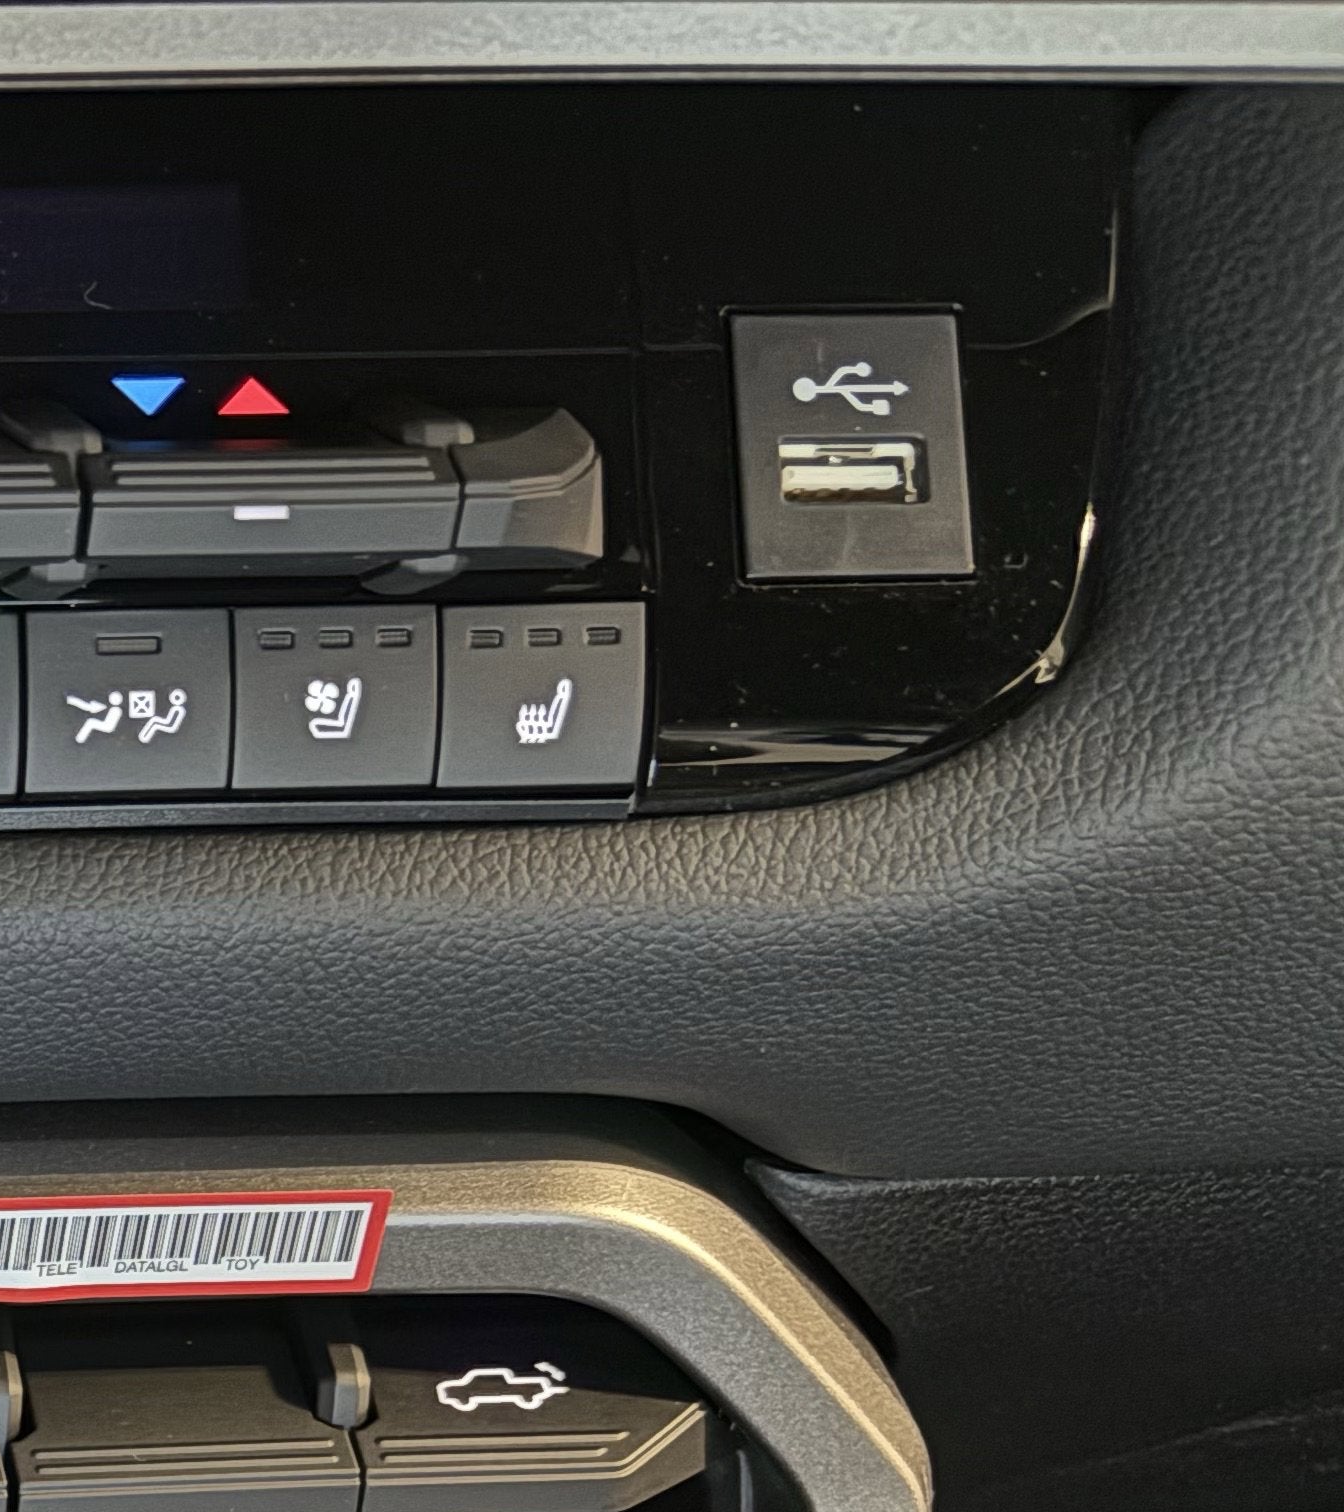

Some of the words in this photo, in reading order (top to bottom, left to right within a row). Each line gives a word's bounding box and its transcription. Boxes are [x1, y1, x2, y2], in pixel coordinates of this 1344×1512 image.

[36, 1262, 78, 1277] TELE
[114, 1259, 189, 1274] DATALGL
[226, 1258, 261, 1271] TOY
